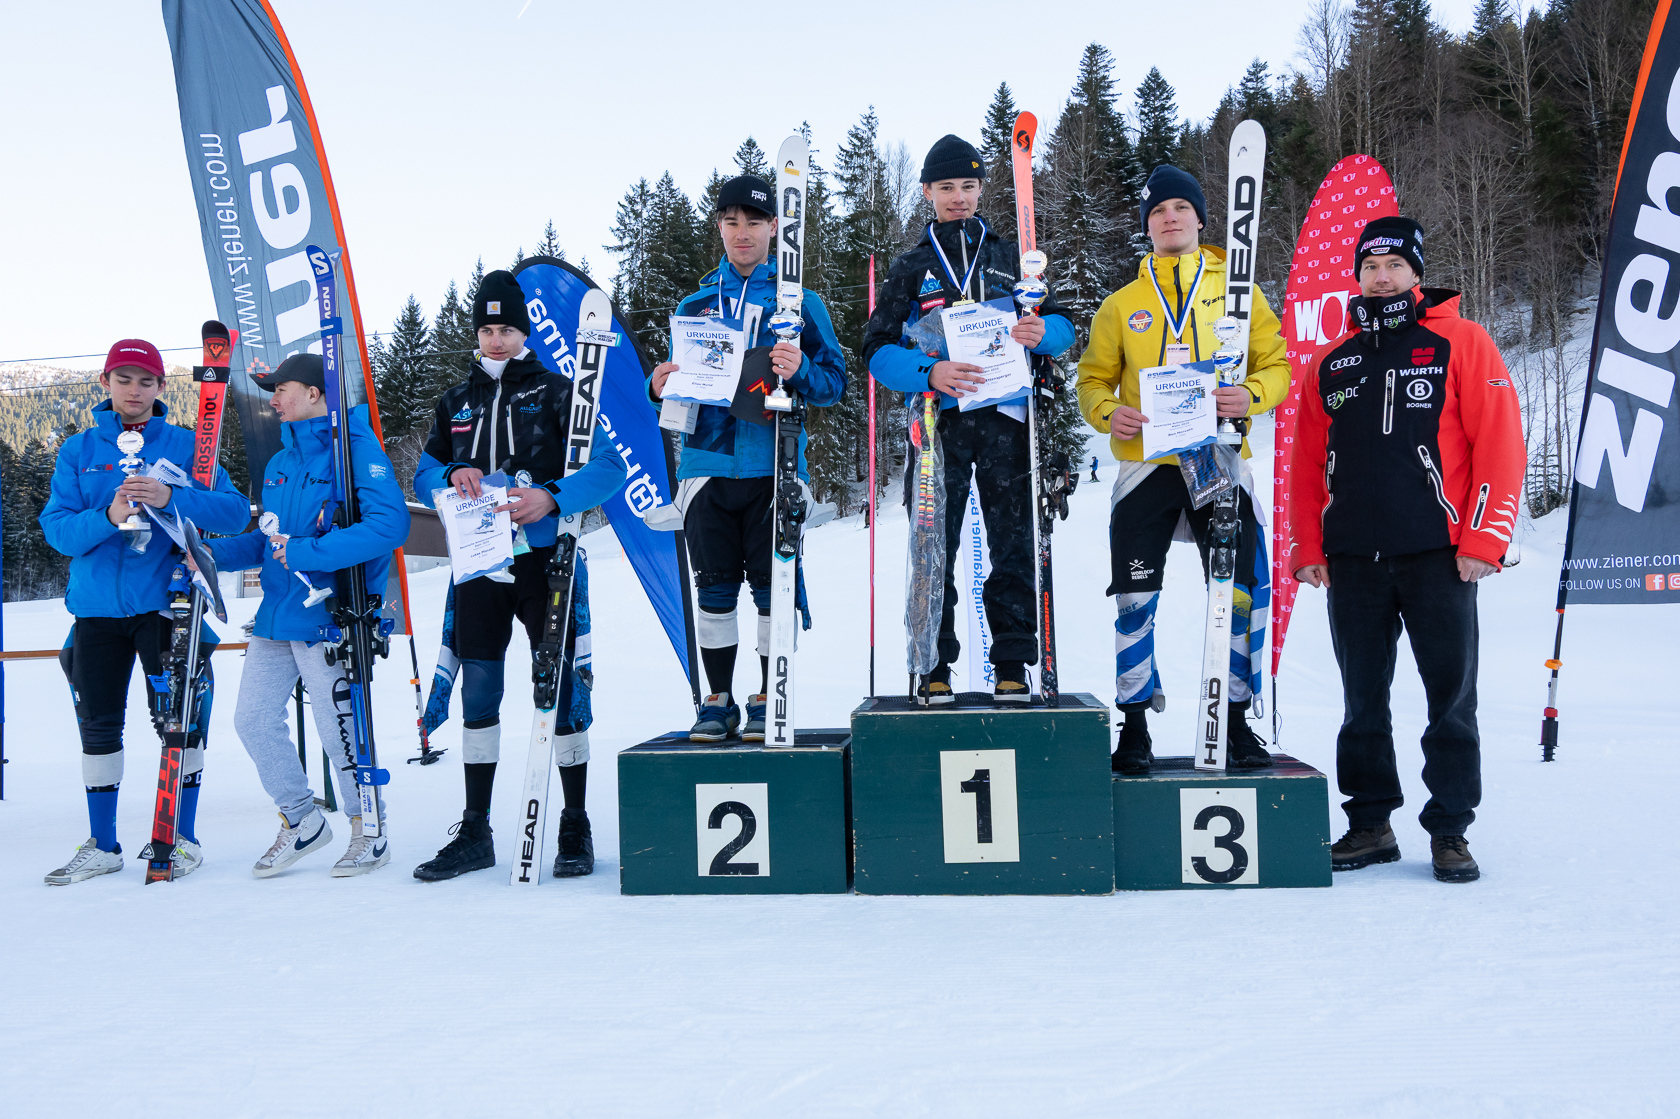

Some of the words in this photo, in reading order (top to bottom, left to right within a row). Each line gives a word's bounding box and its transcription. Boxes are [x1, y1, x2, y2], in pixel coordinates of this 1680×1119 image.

[782, 187, 802, 284] EAD
[1024, 205, 1032, 250] ZARD
[1228, 175, 1256, 320] HEAD
[1360, 236, 1404, 253] Actimel
[920, 279, 941, 294] ASV
[1294, 290, 1359, 346] WO
[1574, 65, 1680, 513] zien
[686, 331, 730, 340] URKUNDE
[959, 317, 1004, 333] URKUNDE
[1155, 379, 1202, 391] URKUNDE
[1400, 366, 1443, 377] WÜRTH
[197, 393, 218, 474] ROSSIGNOL
[452, 409, 473, 420] ASV
[567, 343, 600, 471] HEAD
[456, 493, 496, 512] URKUNDE
[1560, 579, 1604, 591] FOLLOW
[1606, 578, 1622, 589] US
[1625, 578, 1641, 589] ON
[774, 655, 788, 743] HEAD
[1204, 677, 1222, 766] HEAD
[707, 800, 760, 876] 2
[960, 769, 993, 844] 1
[519, 798, 540, 884] HEAD
[1190, 804, 1249, 883] 3
